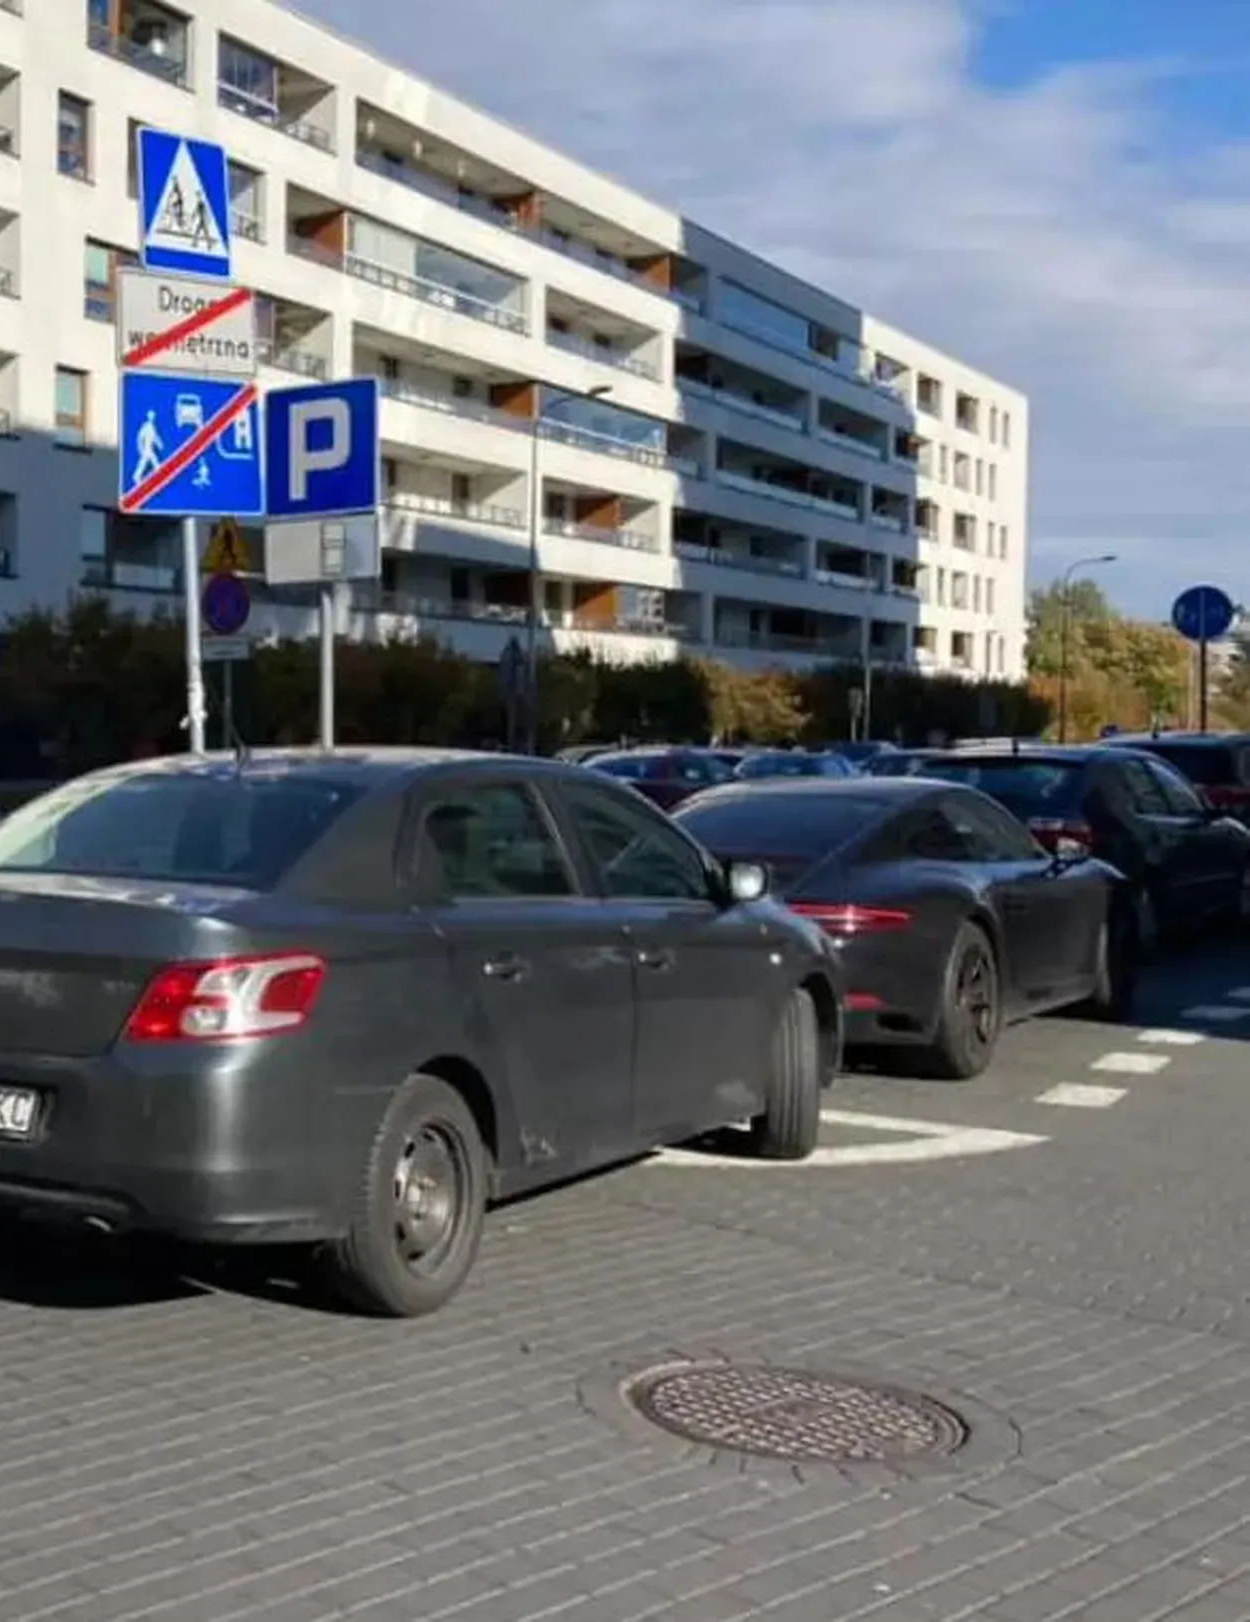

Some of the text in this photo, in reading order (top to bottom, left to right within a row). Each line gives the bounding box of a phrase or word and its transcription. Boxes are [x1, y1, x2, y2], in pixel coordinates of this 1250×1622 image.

[158, 285, 220, 318] Drog
[128, 330, 250, 359] wnętrzna
[288, 397, 351, 501] P
